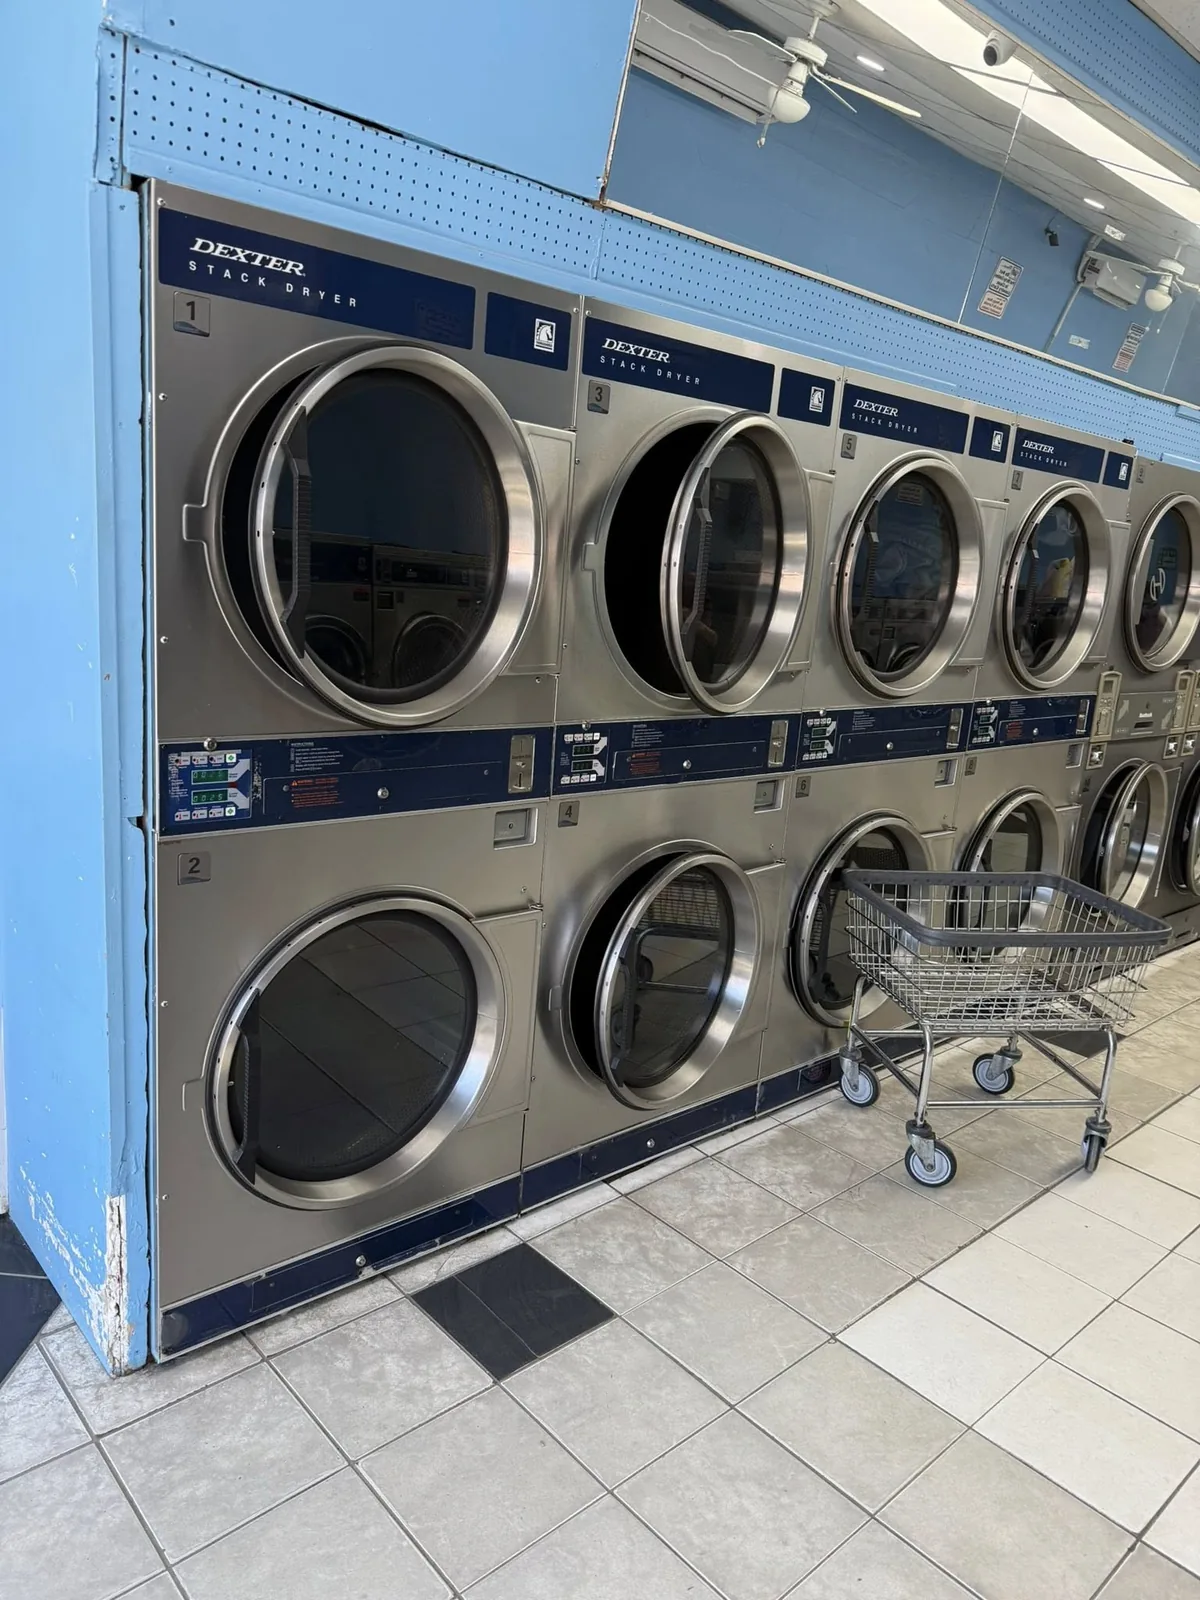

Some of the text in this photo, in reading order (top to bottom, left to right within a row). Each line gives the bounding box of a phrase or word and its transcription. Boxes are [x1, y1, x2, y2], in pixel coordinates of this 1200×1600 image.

[189, 237, 305, 277] DEXTER
[188, 260, 357, 308] STACK DRYER
[185, 300, 197, 321] 1
[602, 338, 670, 363] DEXTER
[600, 355, 700, 385] STACK DRYER
[594, 386, 604, 403] 3
[853, 398, 899, 417] DEXTER
[851, 413, 919, 434] STACK DRYER
[845, 438, 853, 450] 5
[1022, 439, 1055, 454] DEXTER
[800, 780, 807, 792] 6
[565, 806, 574, 819] 4
[188, 857, 201, 875] 2
